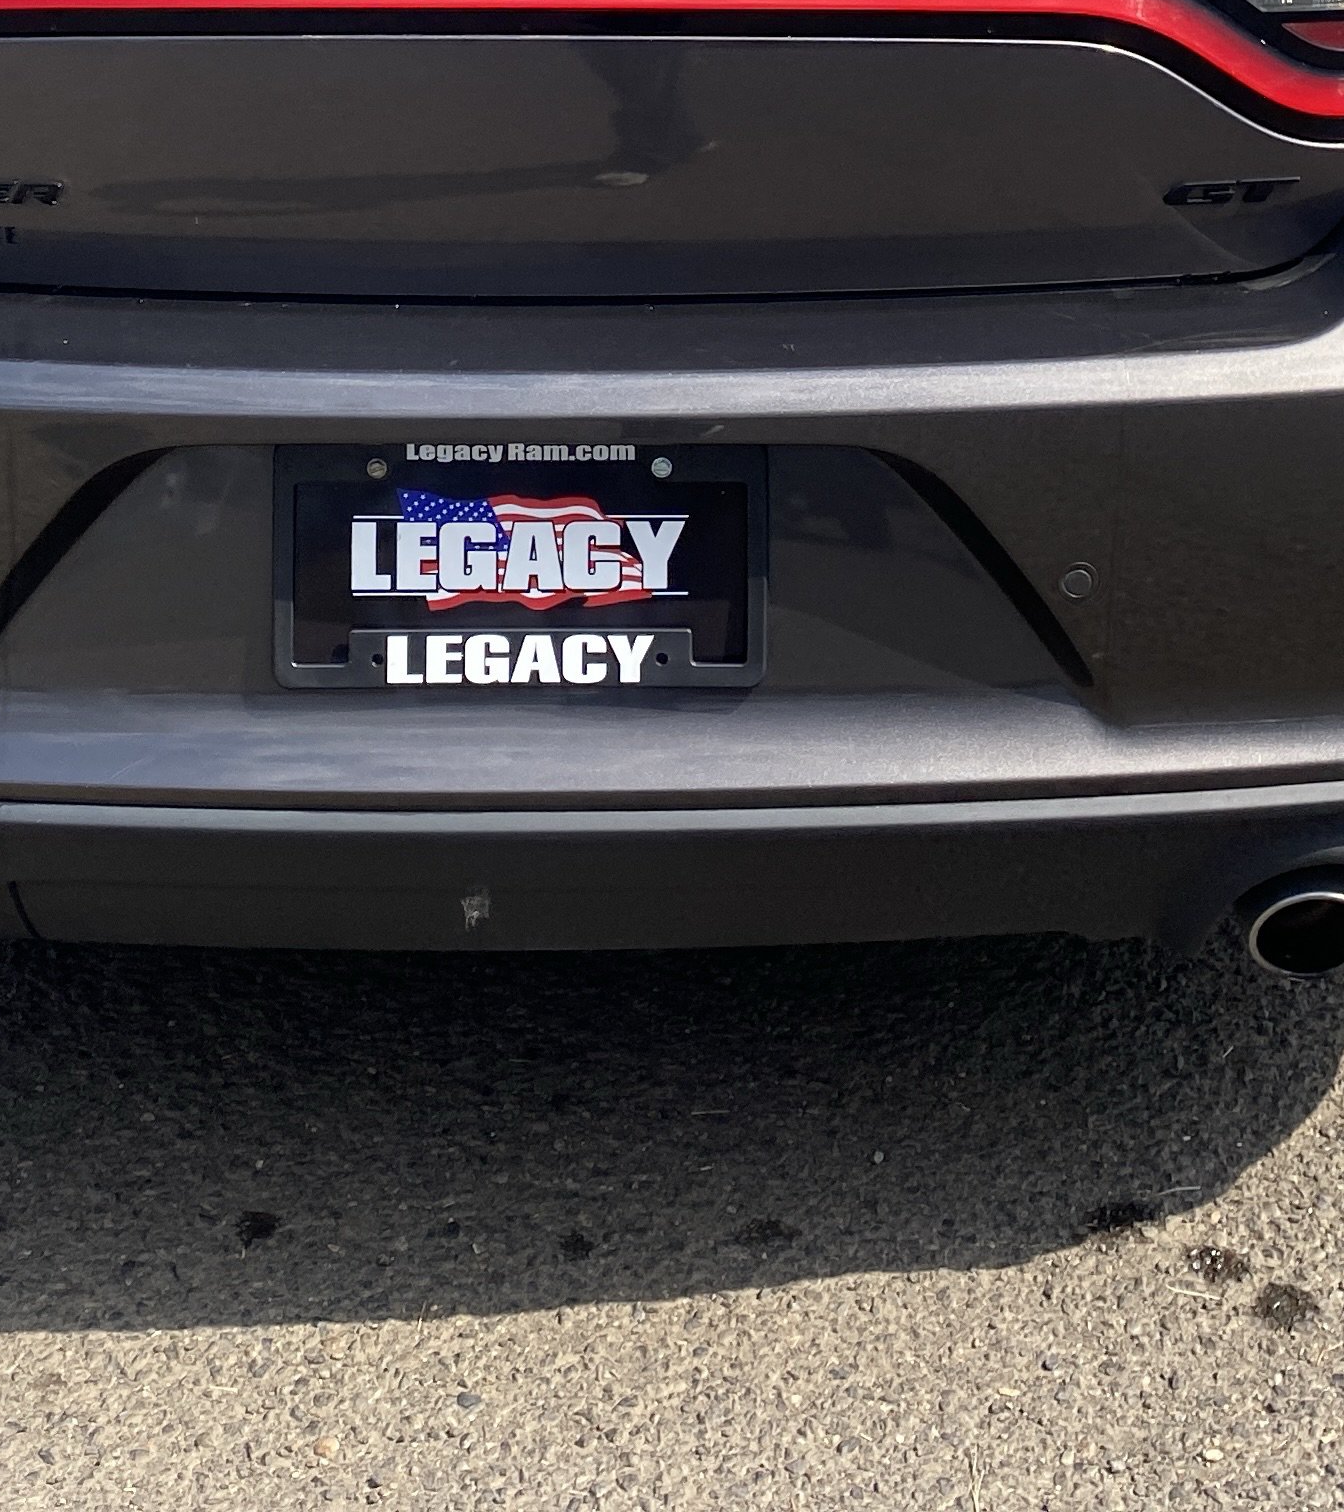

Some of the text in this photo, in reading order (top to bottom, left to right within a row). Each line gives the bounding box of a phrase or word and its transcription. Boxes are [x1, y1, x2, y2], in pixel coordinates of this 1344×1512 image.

[1162, 176, 1301, 206] GT
[406, 443, 636, 462] Legacy Ram.com
[352, 520, 686, 591] LEGACY
[386, 634, 655, 684] LEGACY
